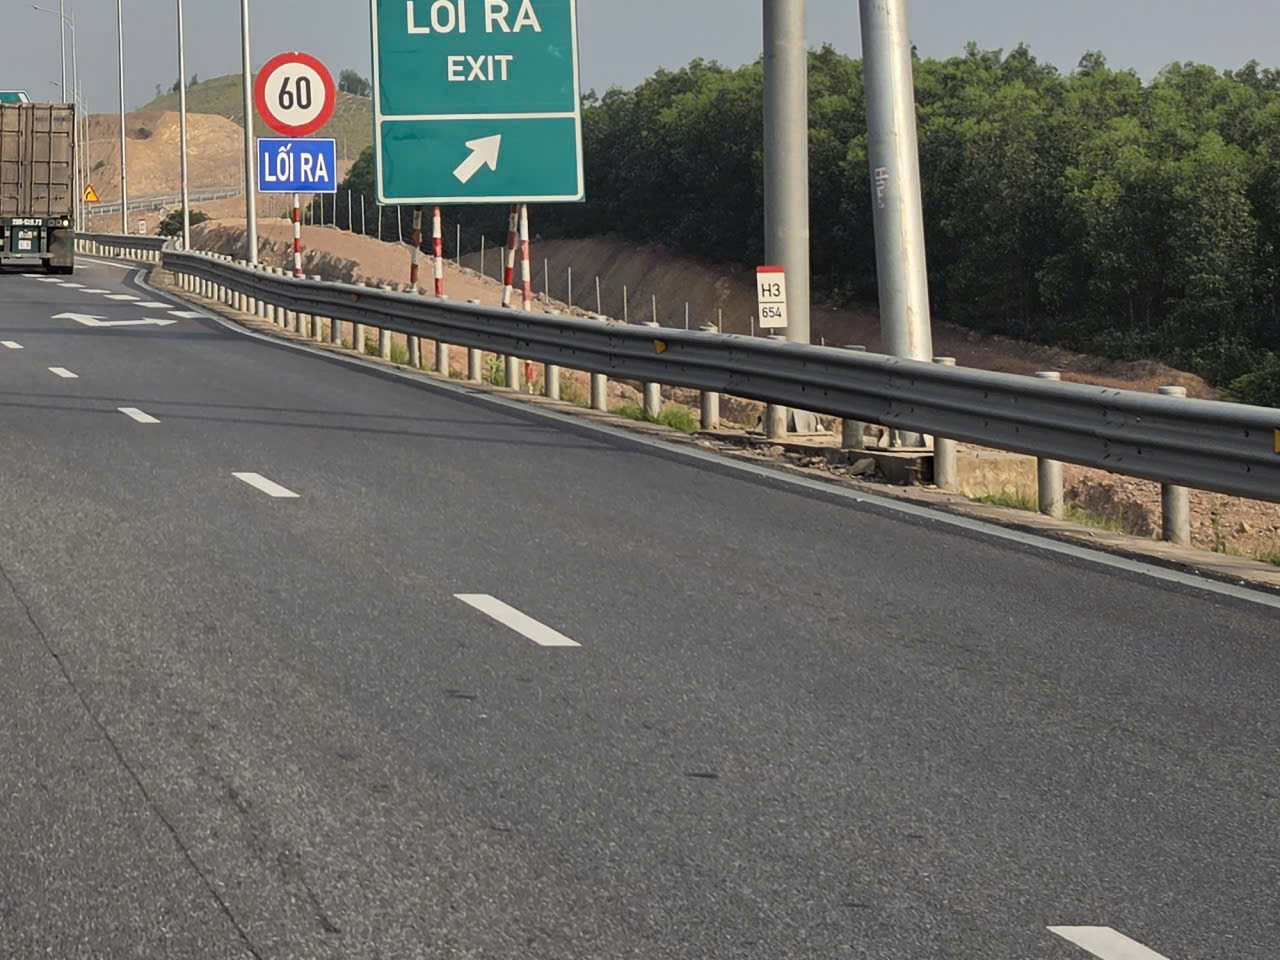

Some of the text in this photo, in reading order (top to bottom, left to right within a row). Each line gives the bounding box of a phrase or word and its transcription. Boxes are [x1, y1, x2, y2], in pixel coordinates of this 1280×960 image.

[447, 54, 514, 82] EXIT
[278, 76, 312, 110] 60
[264, 143, 329, 183] LỐI RA
[761, 283, 781, 298] H3
[762, 306, 782, 319] 654
